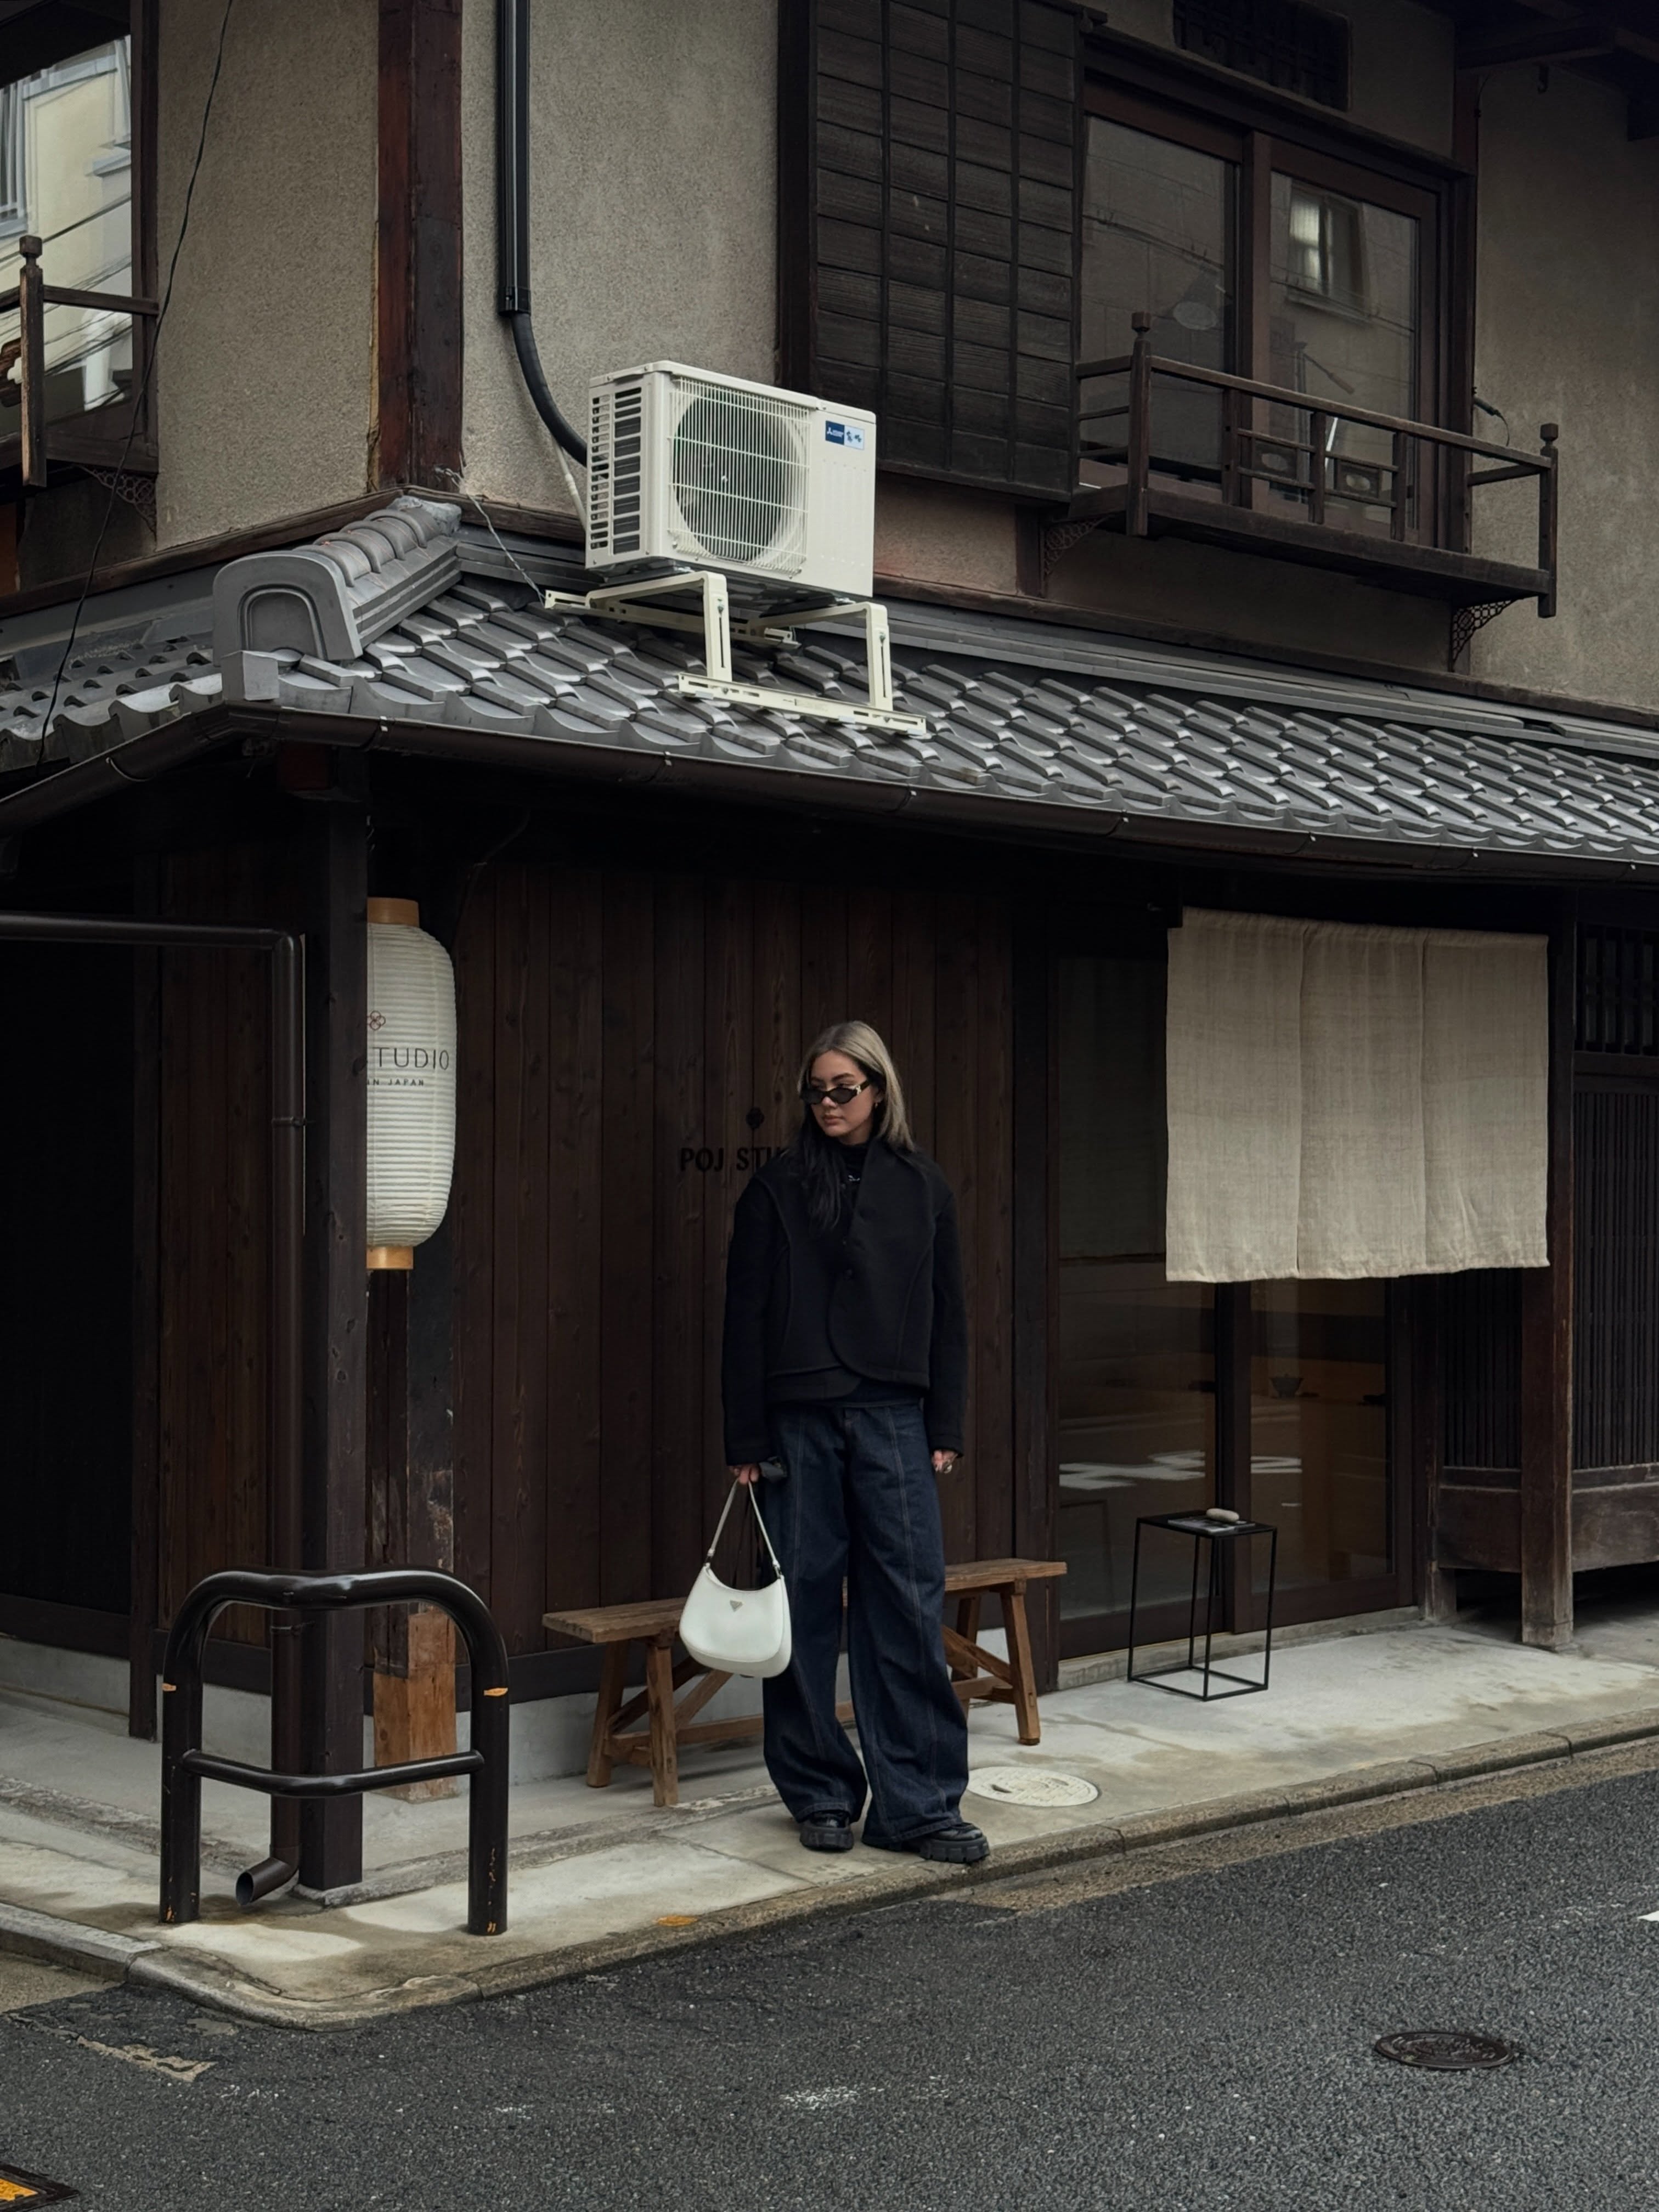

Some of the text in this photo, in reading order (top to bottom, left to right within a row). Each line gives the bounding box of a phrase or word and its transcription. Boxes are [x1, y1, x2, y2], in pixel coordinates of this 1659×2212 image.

[371, 1047, 449, 1070] TUDIO
[388, 1078, 424, 1086] JAPAN
[680, 1147, 724, 1172] POJ
